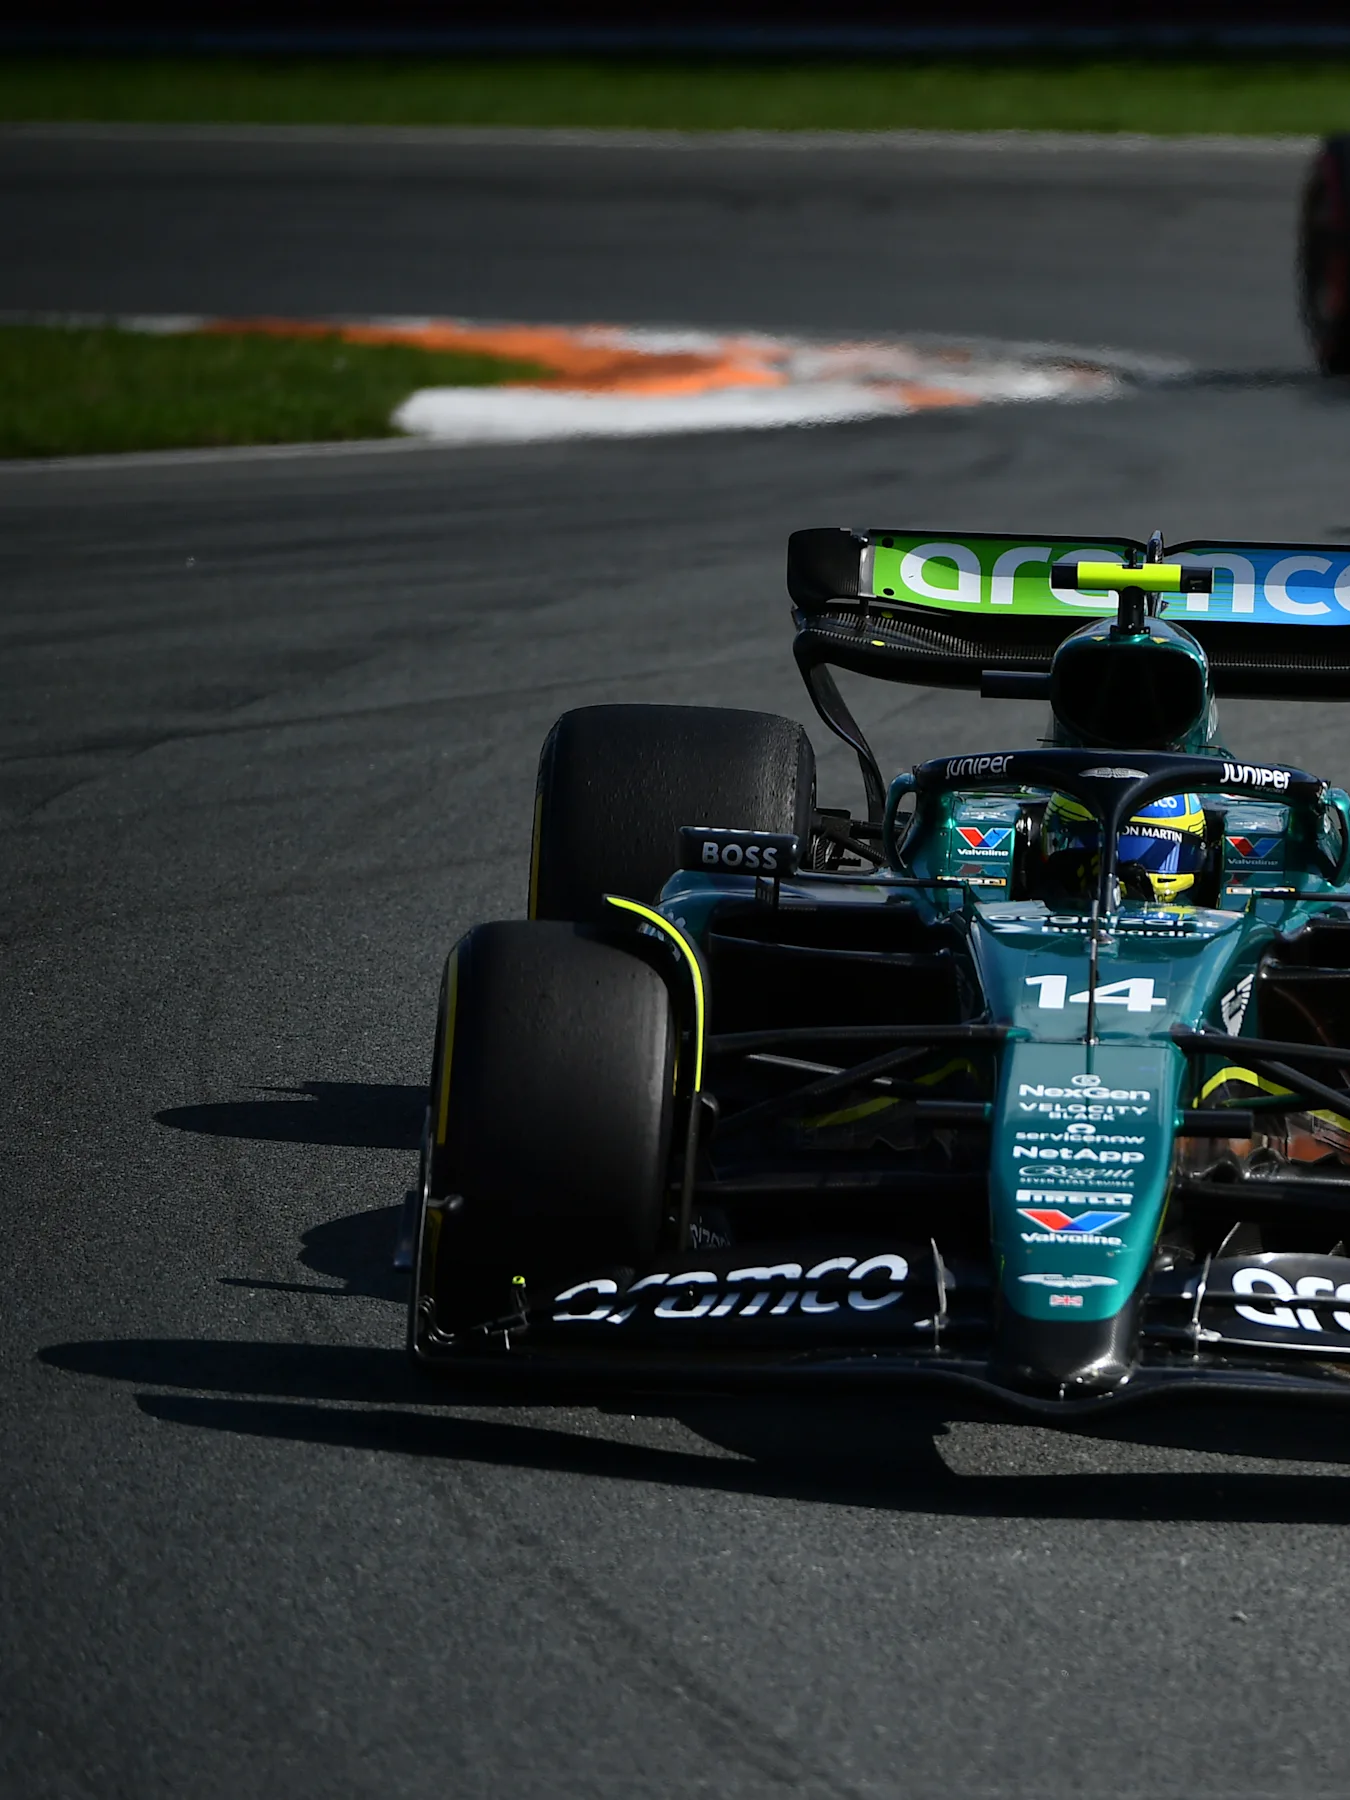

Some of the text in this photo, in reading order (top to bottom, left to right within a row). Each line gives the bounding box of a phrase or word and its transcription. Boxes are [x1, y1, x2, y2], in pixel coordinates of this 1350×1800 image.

[1141, 826, 1183, 843] MARTIN
[702, 841, 778, 870] BOSS
[957, 848, 1009, 857] Valvoline
[1227, 858, 1279, 866] Valvoline
[1025, 974, 1167, 1012] 14
[1019, 1084, 1151, 1101] NexGen
[1019, 1102, 1148, 1115] VELOCITY
[1049, 1111, 1115, 1121] BLACK
[1012, 1145, 1145, 1164] NetApp
[1020, 1232, 1123, 1247] Valvoline
[552, 1254, 909, 1325] aramco
